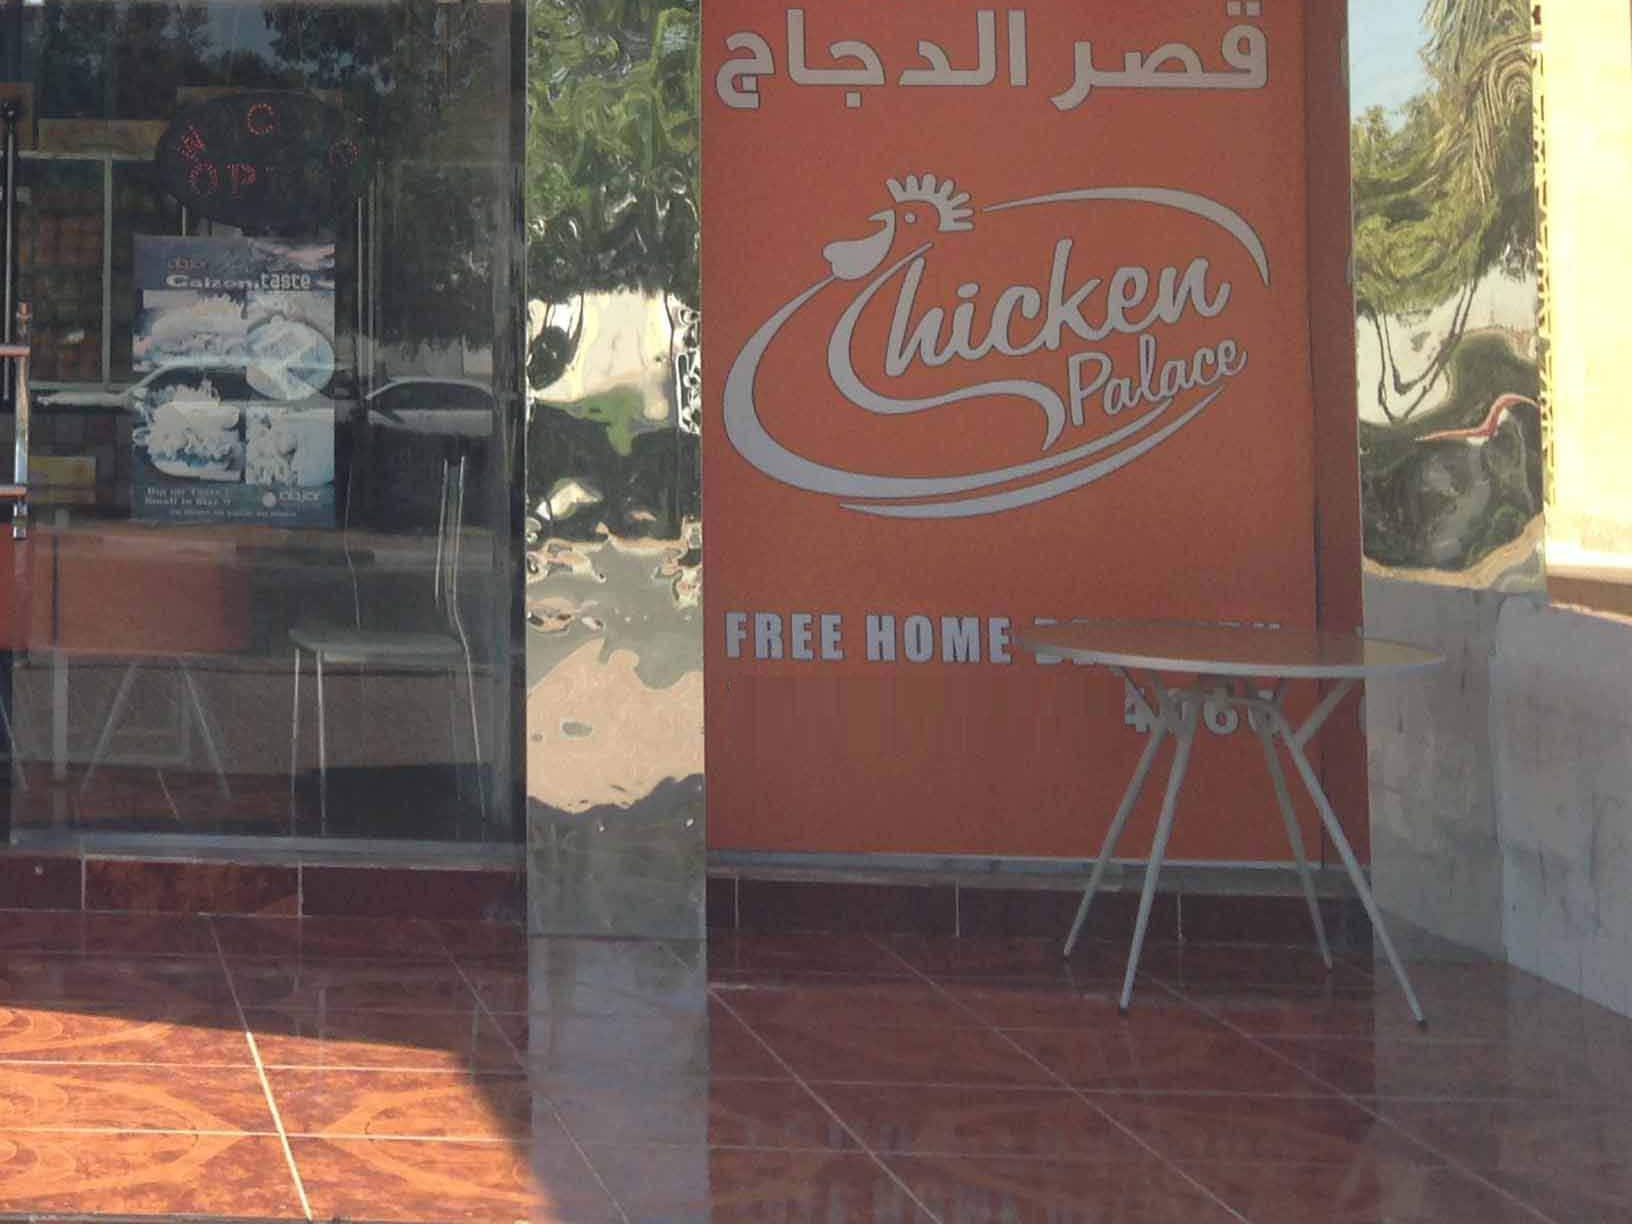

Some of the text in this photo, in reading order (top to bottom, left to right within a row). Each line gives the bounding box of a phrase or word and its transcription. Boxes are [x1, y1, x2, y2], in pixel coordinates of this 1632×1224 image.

[716, 0, 1269, 111] قصر الدجاج
[827, 238, 1231, 416] Chicken
[1069, 334, 1248, 427] Palace
[724, 611, 844, 661] FREE
[865, 613, 1014, 665] HOME
